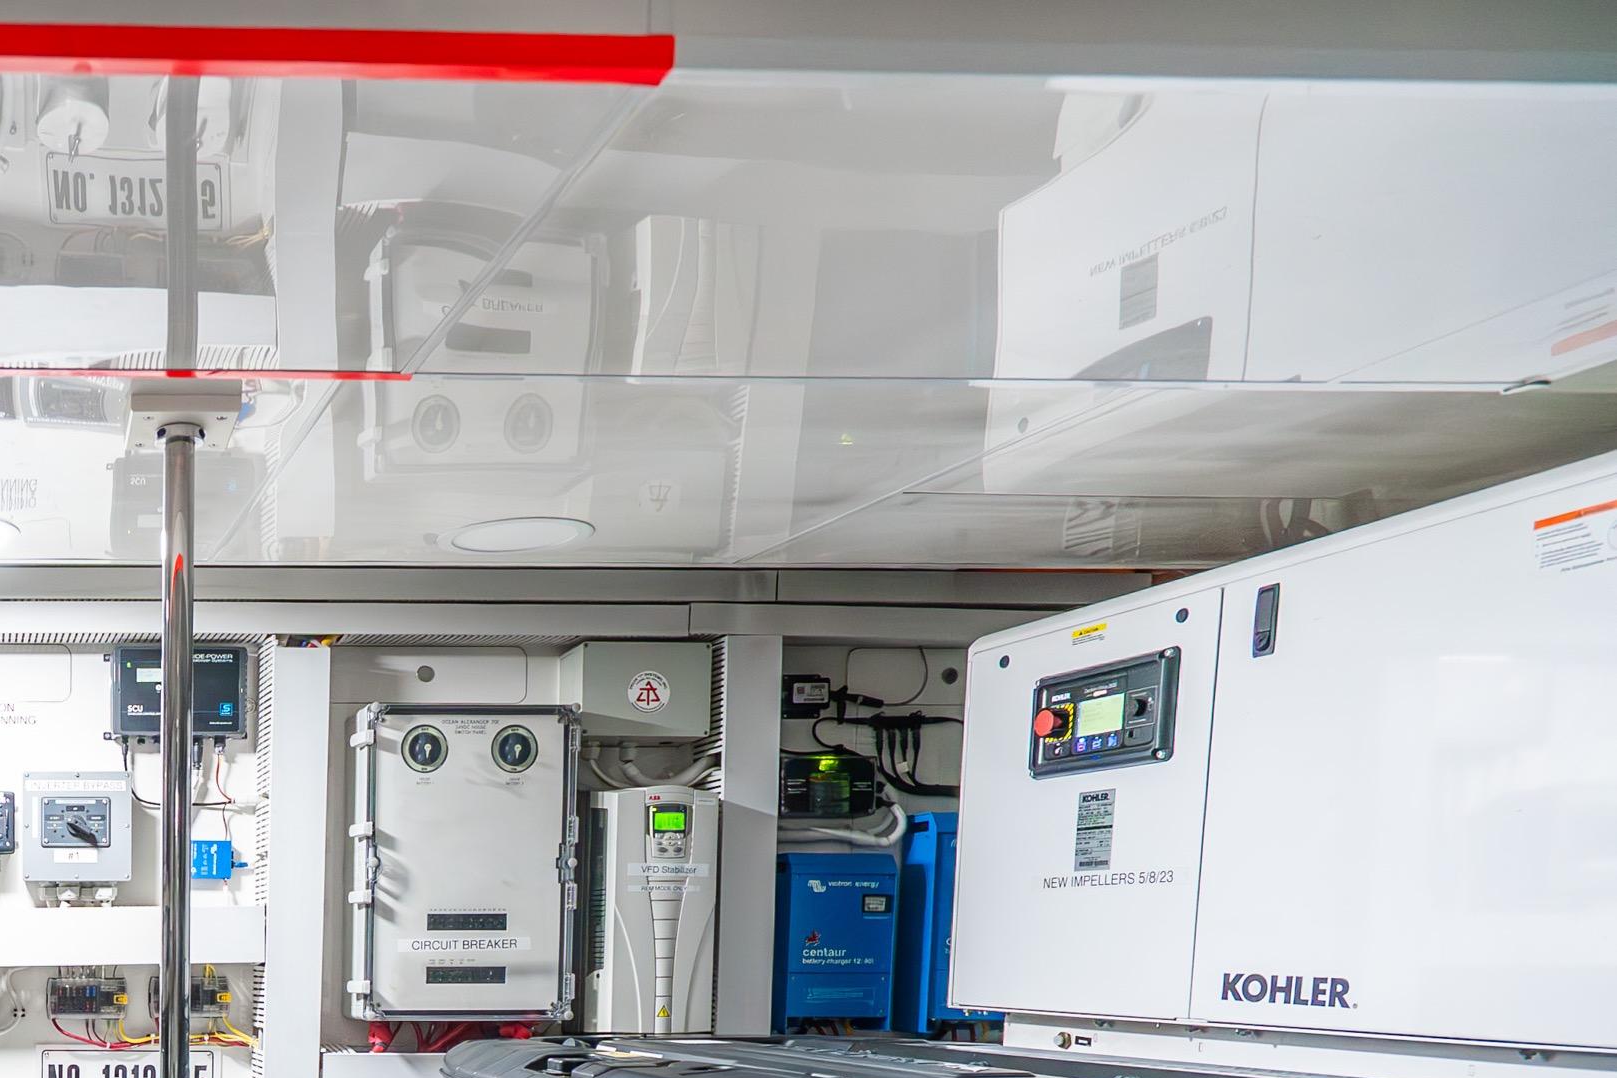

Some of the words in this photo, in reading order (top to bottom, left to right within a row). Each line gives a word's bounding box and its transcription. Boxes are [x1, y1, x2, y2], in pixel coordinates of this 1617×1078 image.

[127, 704, 143, 713] SCU
[1082, 792, 1110, 804] KOHLER
[641, 865, 660, 874] VFD
[661, 865, 697, 875] Stabilizer
[1043, 877, 1068, 889] NEW
[1071, 872, 1135, 888] IMPELLERS
[1138, 869, 1174, 884] 5/8/23
[411, 940, 459, 950] CIRCUIT
[462, 938, 518, 950] BREAKER
[802, 947, 847, 957] centaur
[1221, 972, 1351, 1009] KOHLER
